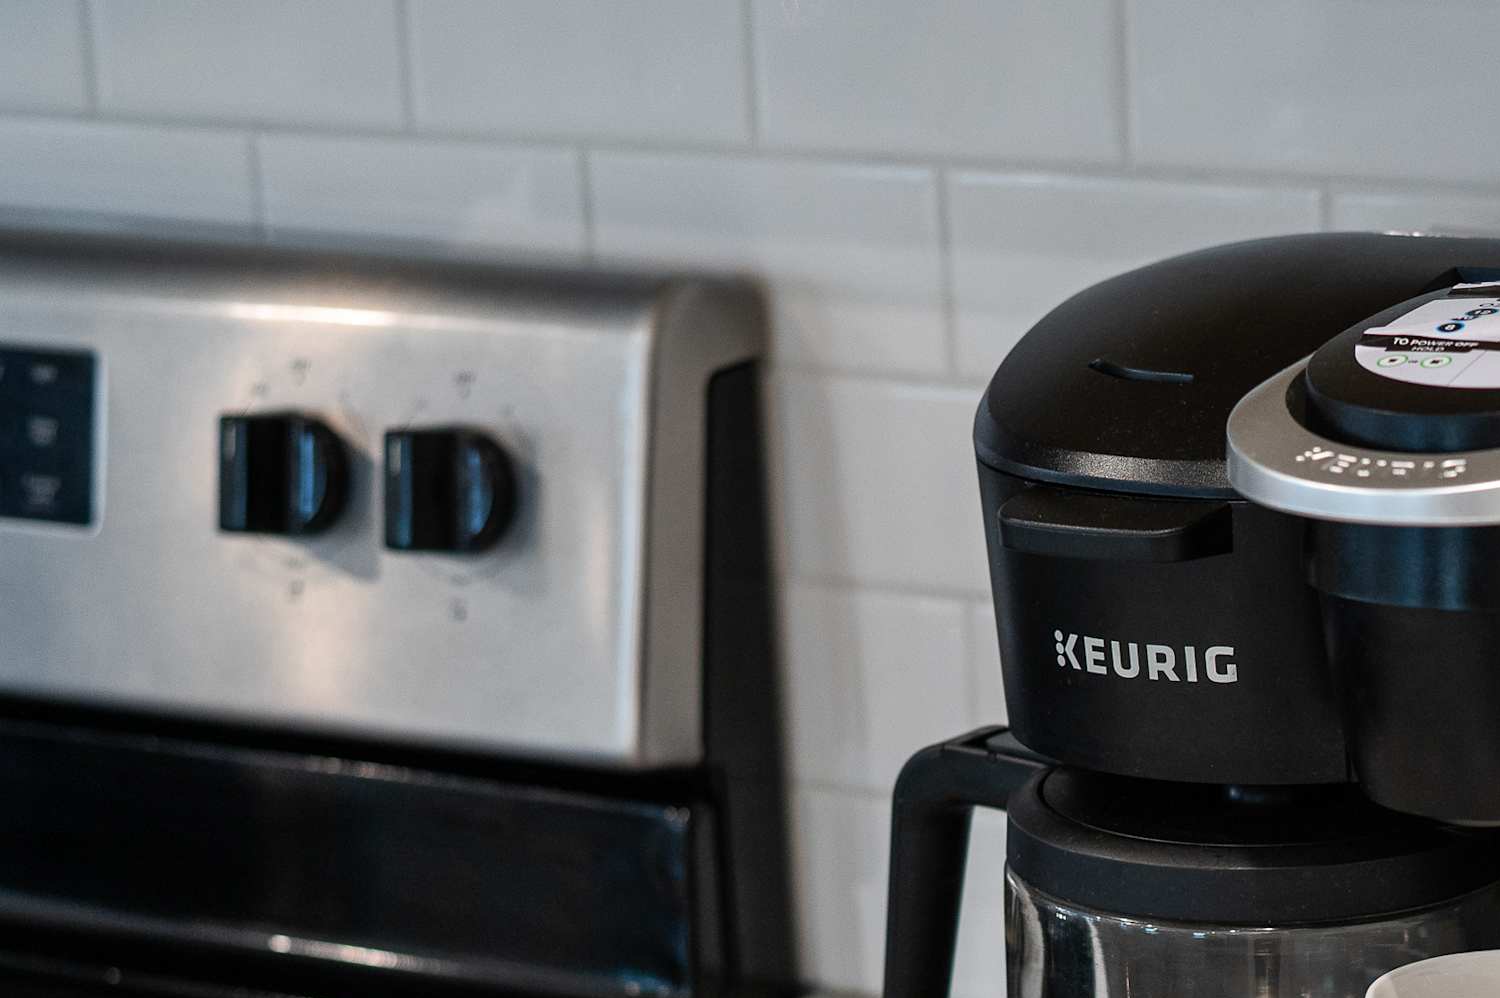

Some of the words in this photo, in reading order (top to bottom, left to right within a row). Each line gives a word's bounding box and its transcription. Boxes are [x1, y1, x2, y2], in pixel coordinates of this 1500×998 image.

[1393, 337, 1409, 346] TO
[1410, 339, 1453, 347] POWER
[1054, 630, 1238, 683] KEURIG
